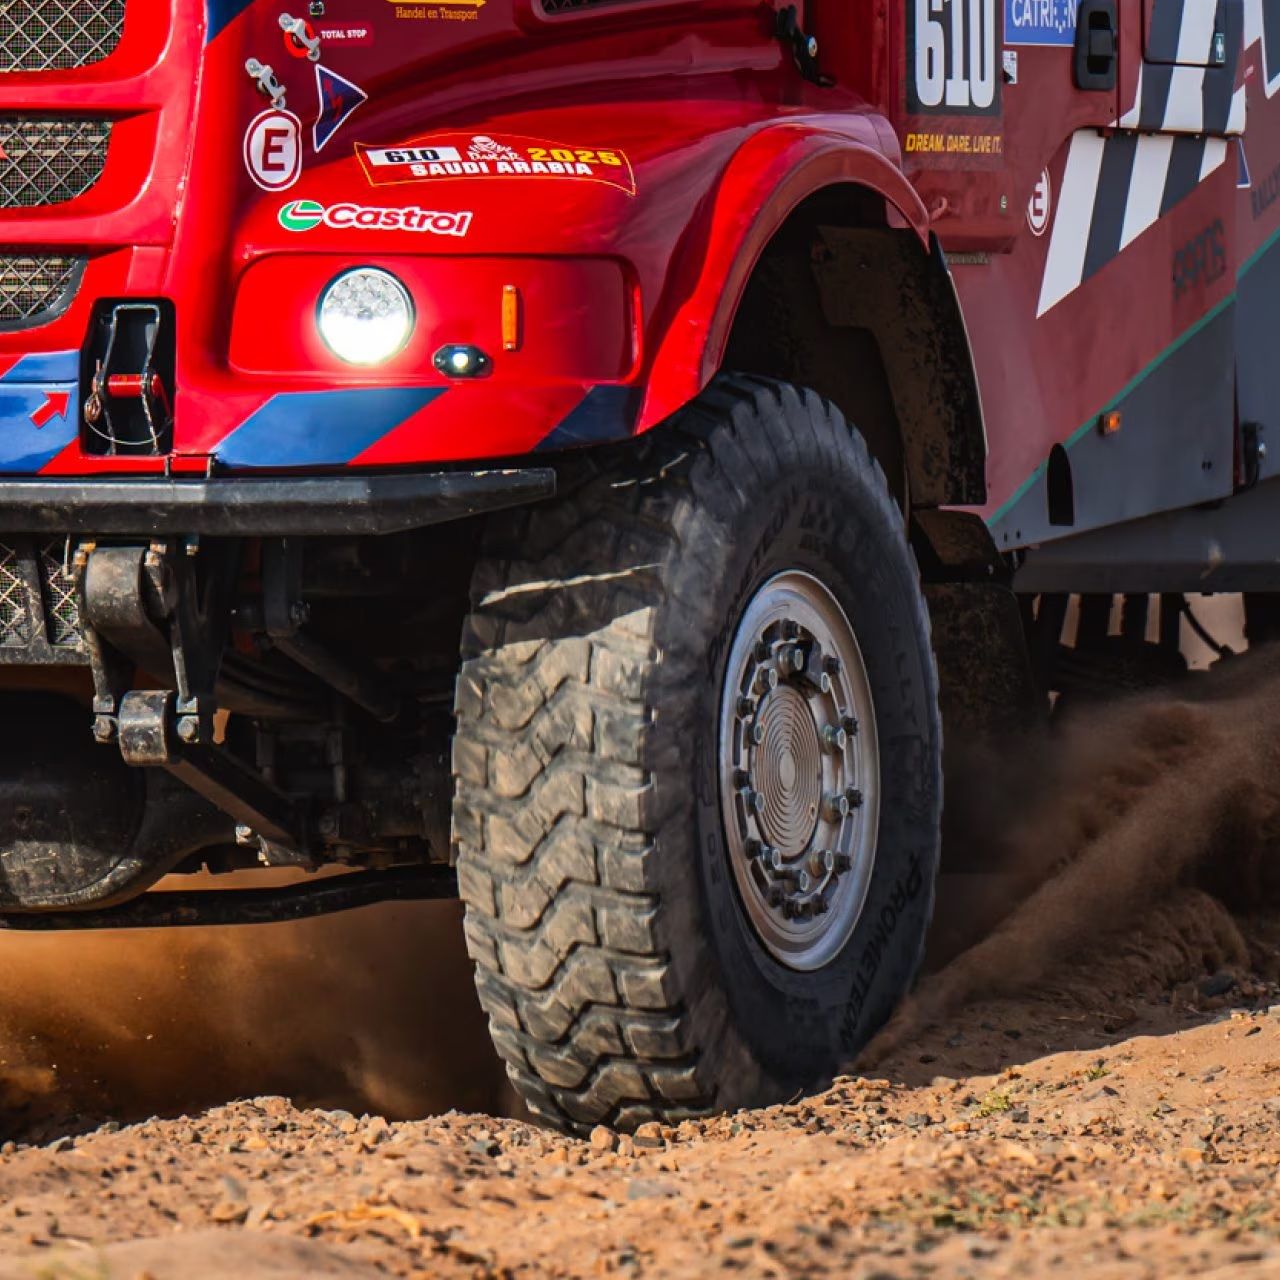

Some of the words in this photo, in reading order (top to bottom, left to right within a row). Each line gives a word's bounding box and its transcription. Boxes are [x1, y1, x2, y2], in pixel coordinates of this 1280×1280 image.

[395, 7, 426, 18] Handel
[427, 10, 438, 19] en
[439, 7, 478, 21] Transport
[321, 30, 345, 39] TOTAL
[348, 29, 367, 38] STOP
[262, 127, 290, 172] E
[905, 133, 945, 152] DREAM.
[946, 135, 971, 153] DARE.
[972, 136, 991, 153] LIVE
[384, 149, 440, 163] 610
[527, 147, 622, 165] 2025
[410, 160, 489, 177] SAUDI
[497, 161, 593, 176] ARABIA
[322, 203, 473, 237] Castrol
